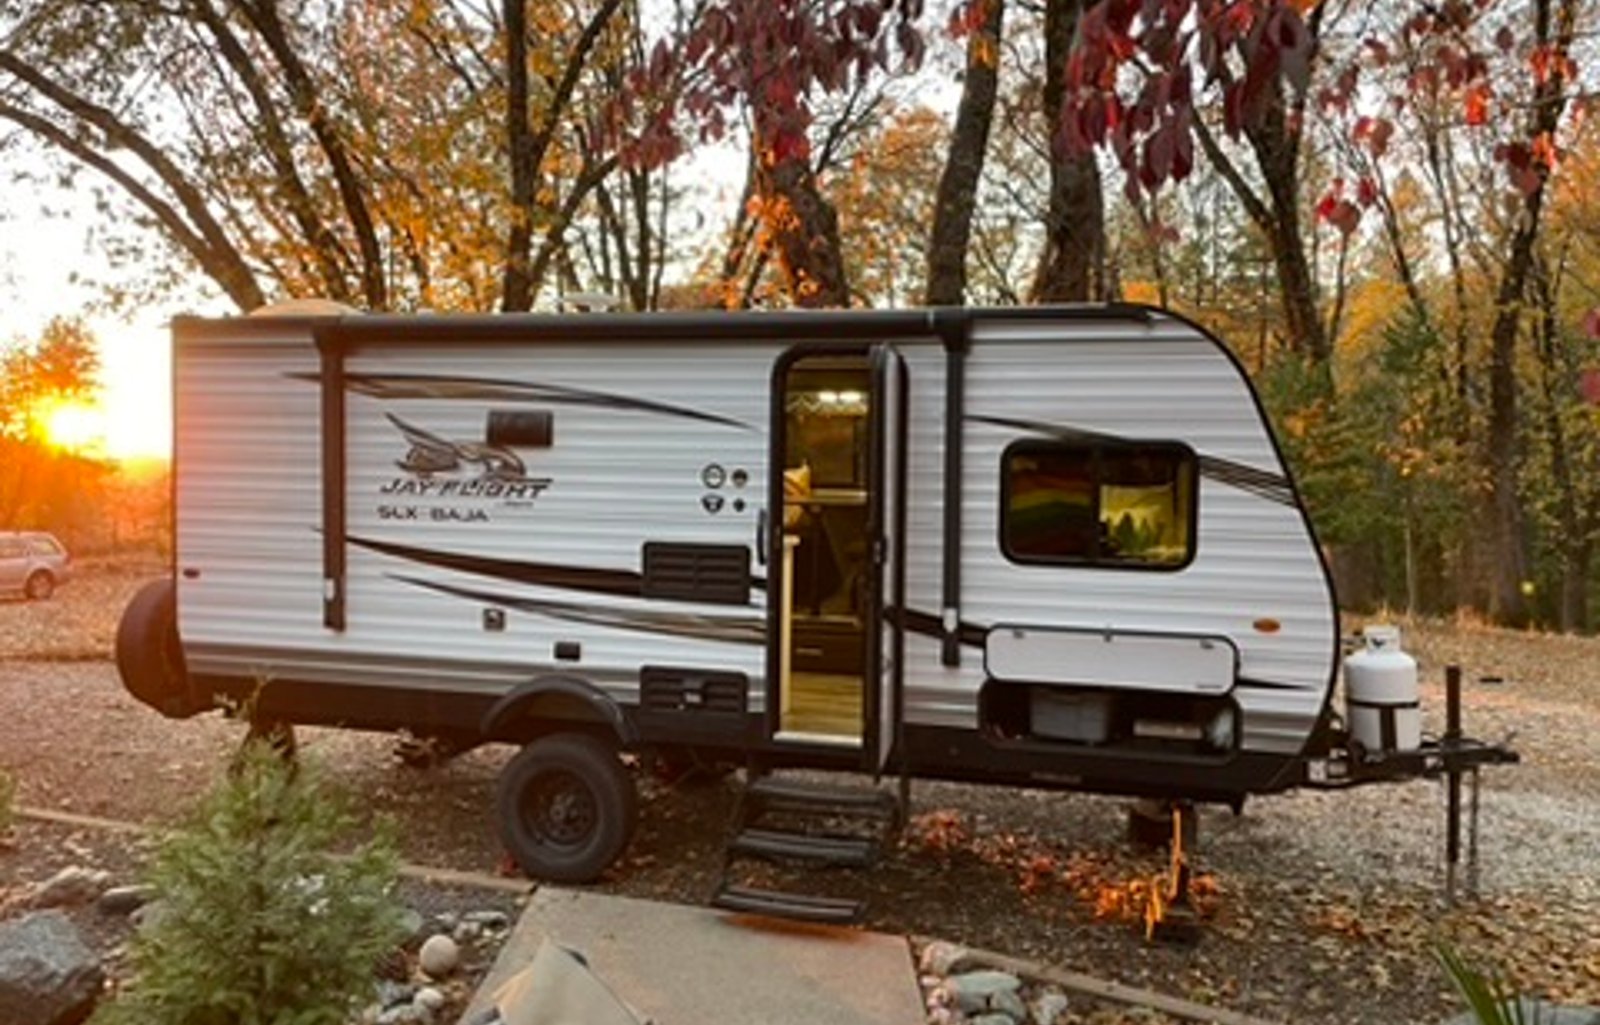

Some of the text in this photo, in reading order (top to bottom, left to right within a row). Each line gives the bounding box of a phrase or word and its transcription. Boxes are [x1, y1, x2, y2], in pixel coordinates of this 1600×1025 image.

[380, 479, 549, 499] JAY FLIGHT
[377, 505, 490, 522] SLX BAJA
